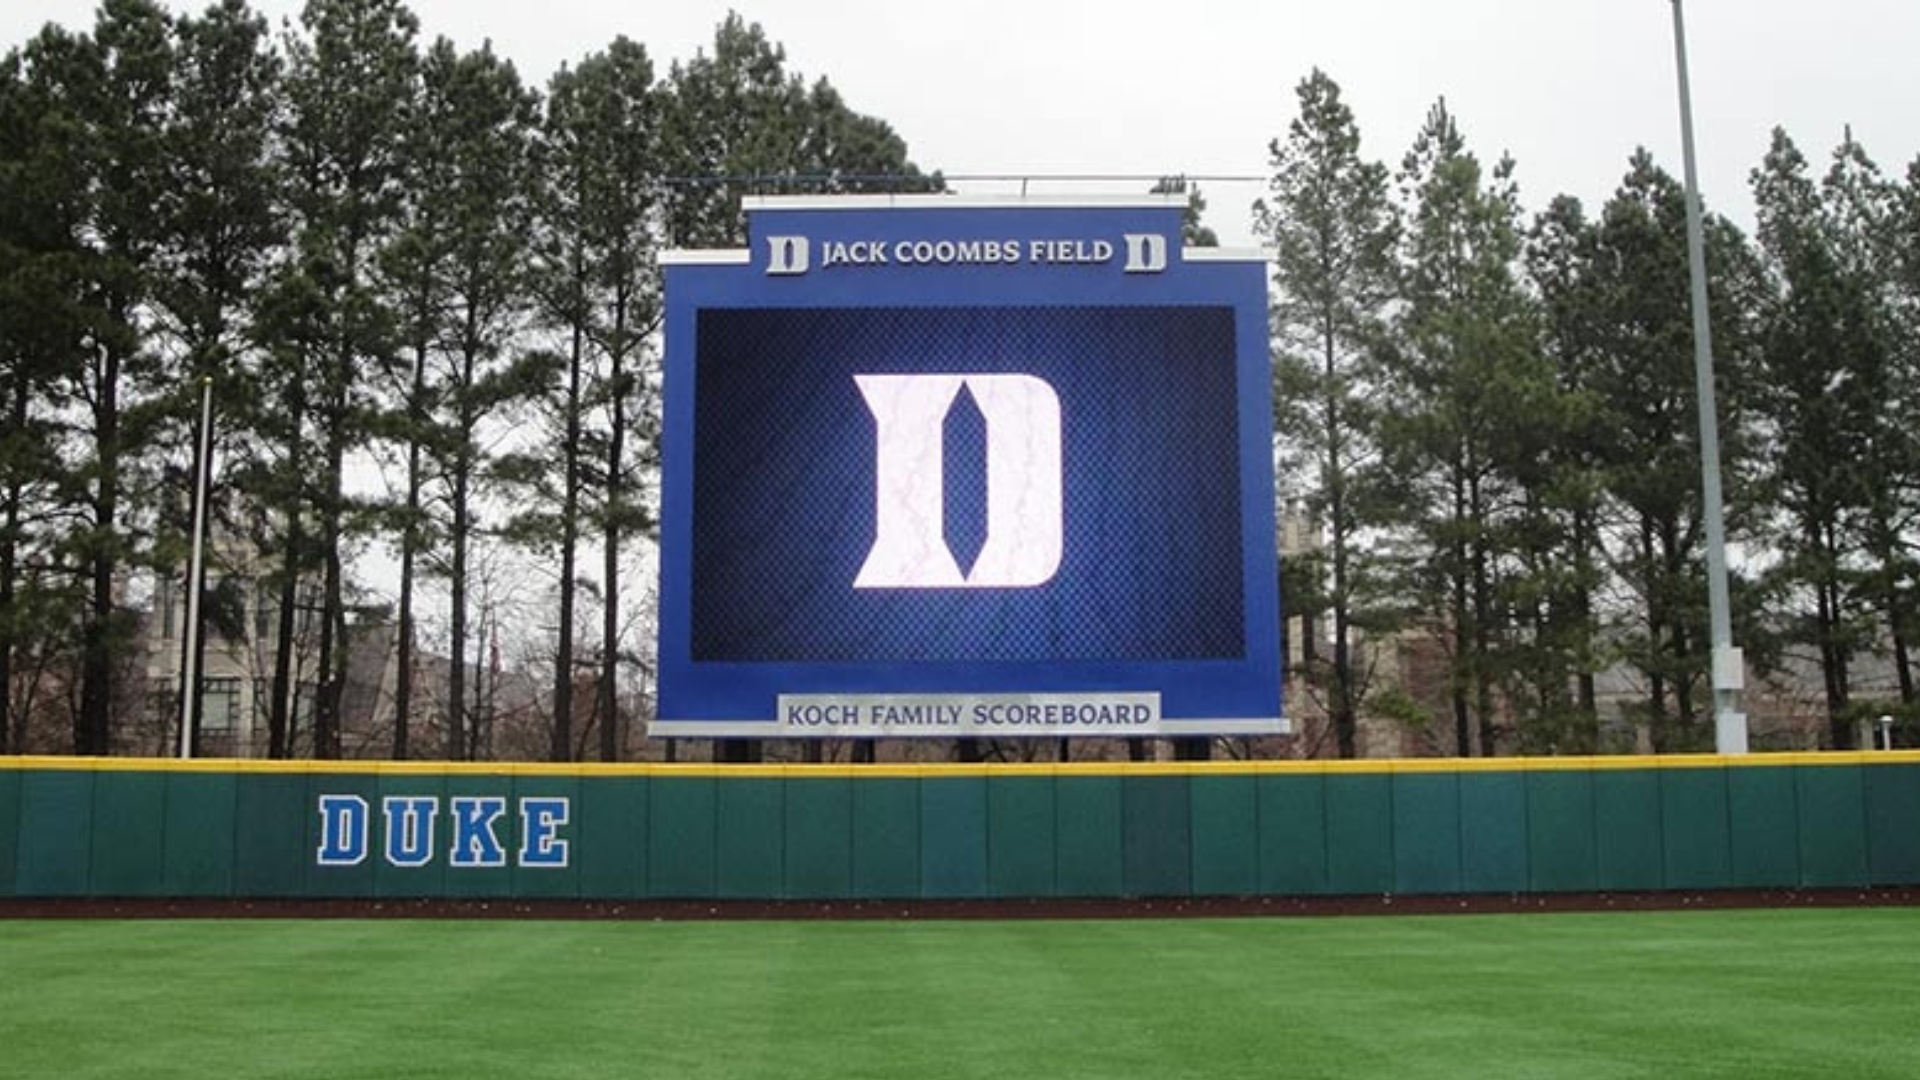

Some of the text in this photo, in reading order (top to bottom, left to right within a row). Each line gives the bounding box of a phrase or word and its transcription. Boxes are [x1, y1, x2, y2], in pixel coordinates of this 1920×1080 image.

[766, 236, 809, 273] D
[822, 240, 1113, 267] JACK COOMBS FIELD
[1123, 234, 1167, 272] D
[852, 373, 1063, 588] D
[787, 703, 1151, 726] KOCH FAMILY SCOREBOARD
[317, 794, 570, 867] DUKE
